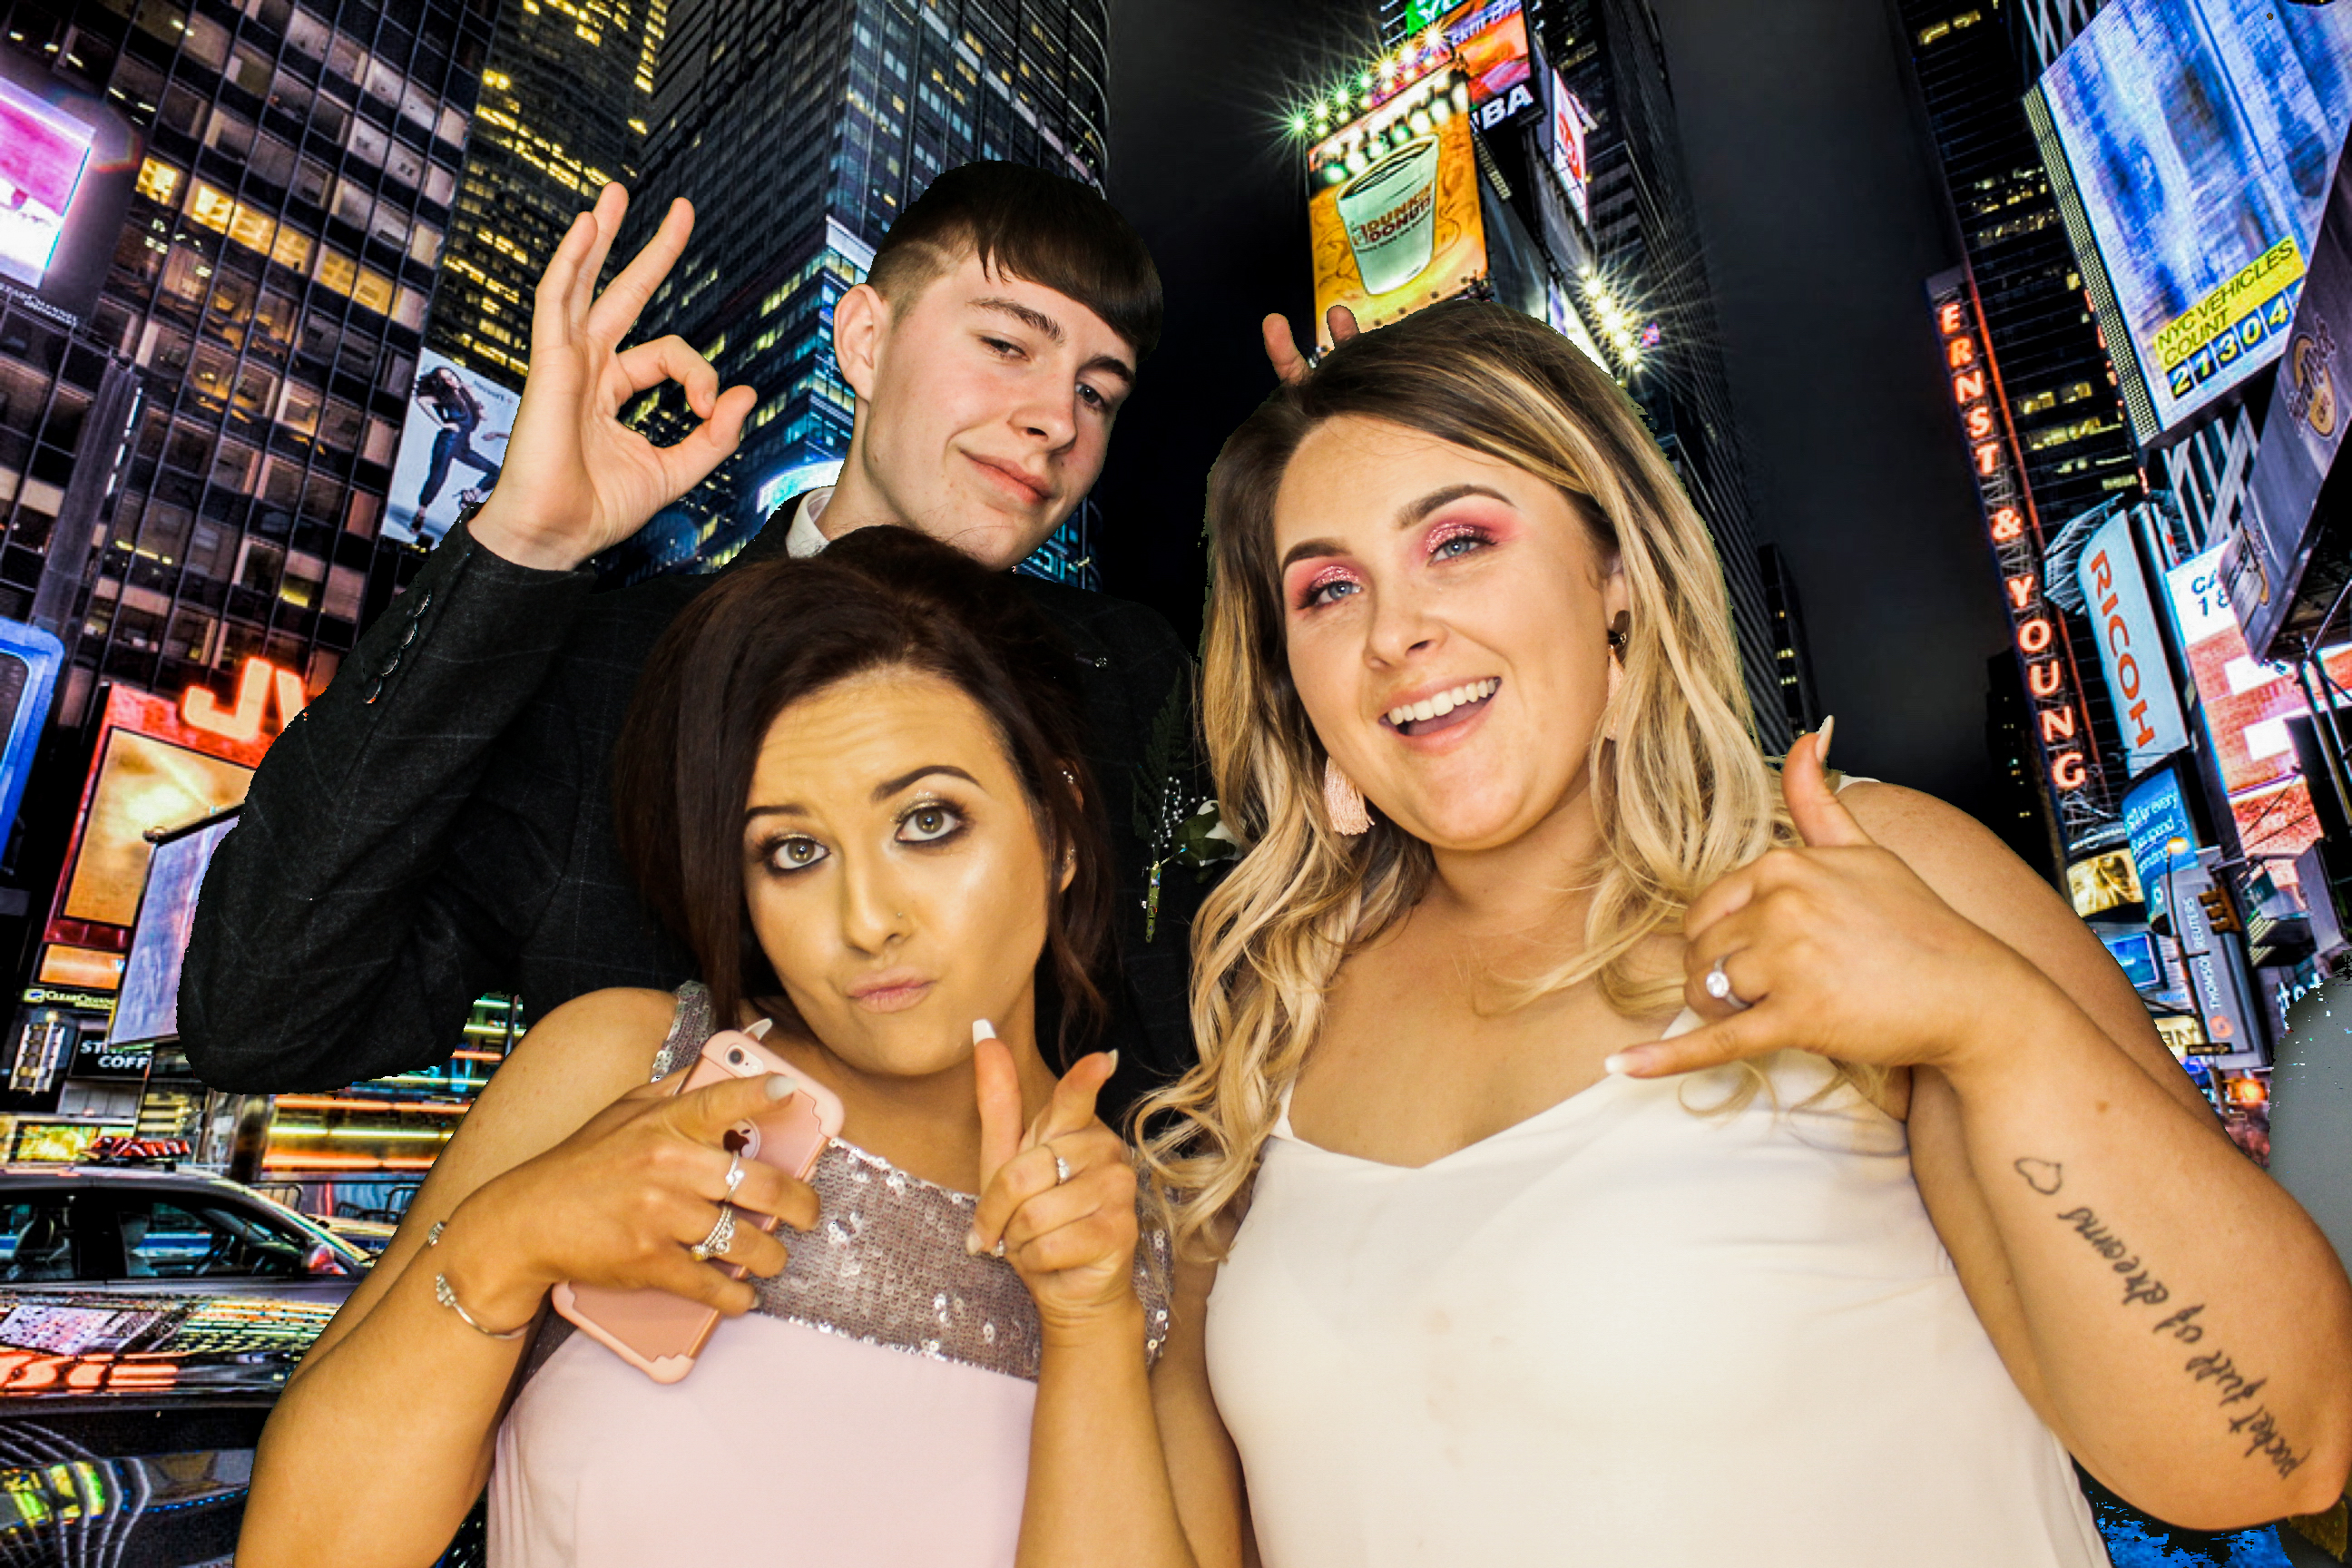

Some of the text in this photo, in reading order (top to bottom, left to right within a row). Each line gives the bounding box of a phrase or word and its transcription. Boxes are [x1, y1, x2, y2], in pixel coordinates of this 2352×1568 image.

[2158, 239, 2293, 349] NYC VEHICLES
[2164, 308, 2229, 366] COUNT
[1938, 301, 2086, 790] ERNST & YOUNG
[2090, 549, 2155, 749] RICOH
[2056, 1207, 2170, 1306] dreams
[2152, 1303, 2206, 1344] of
[2185, 1349, 2267, 1406] full
